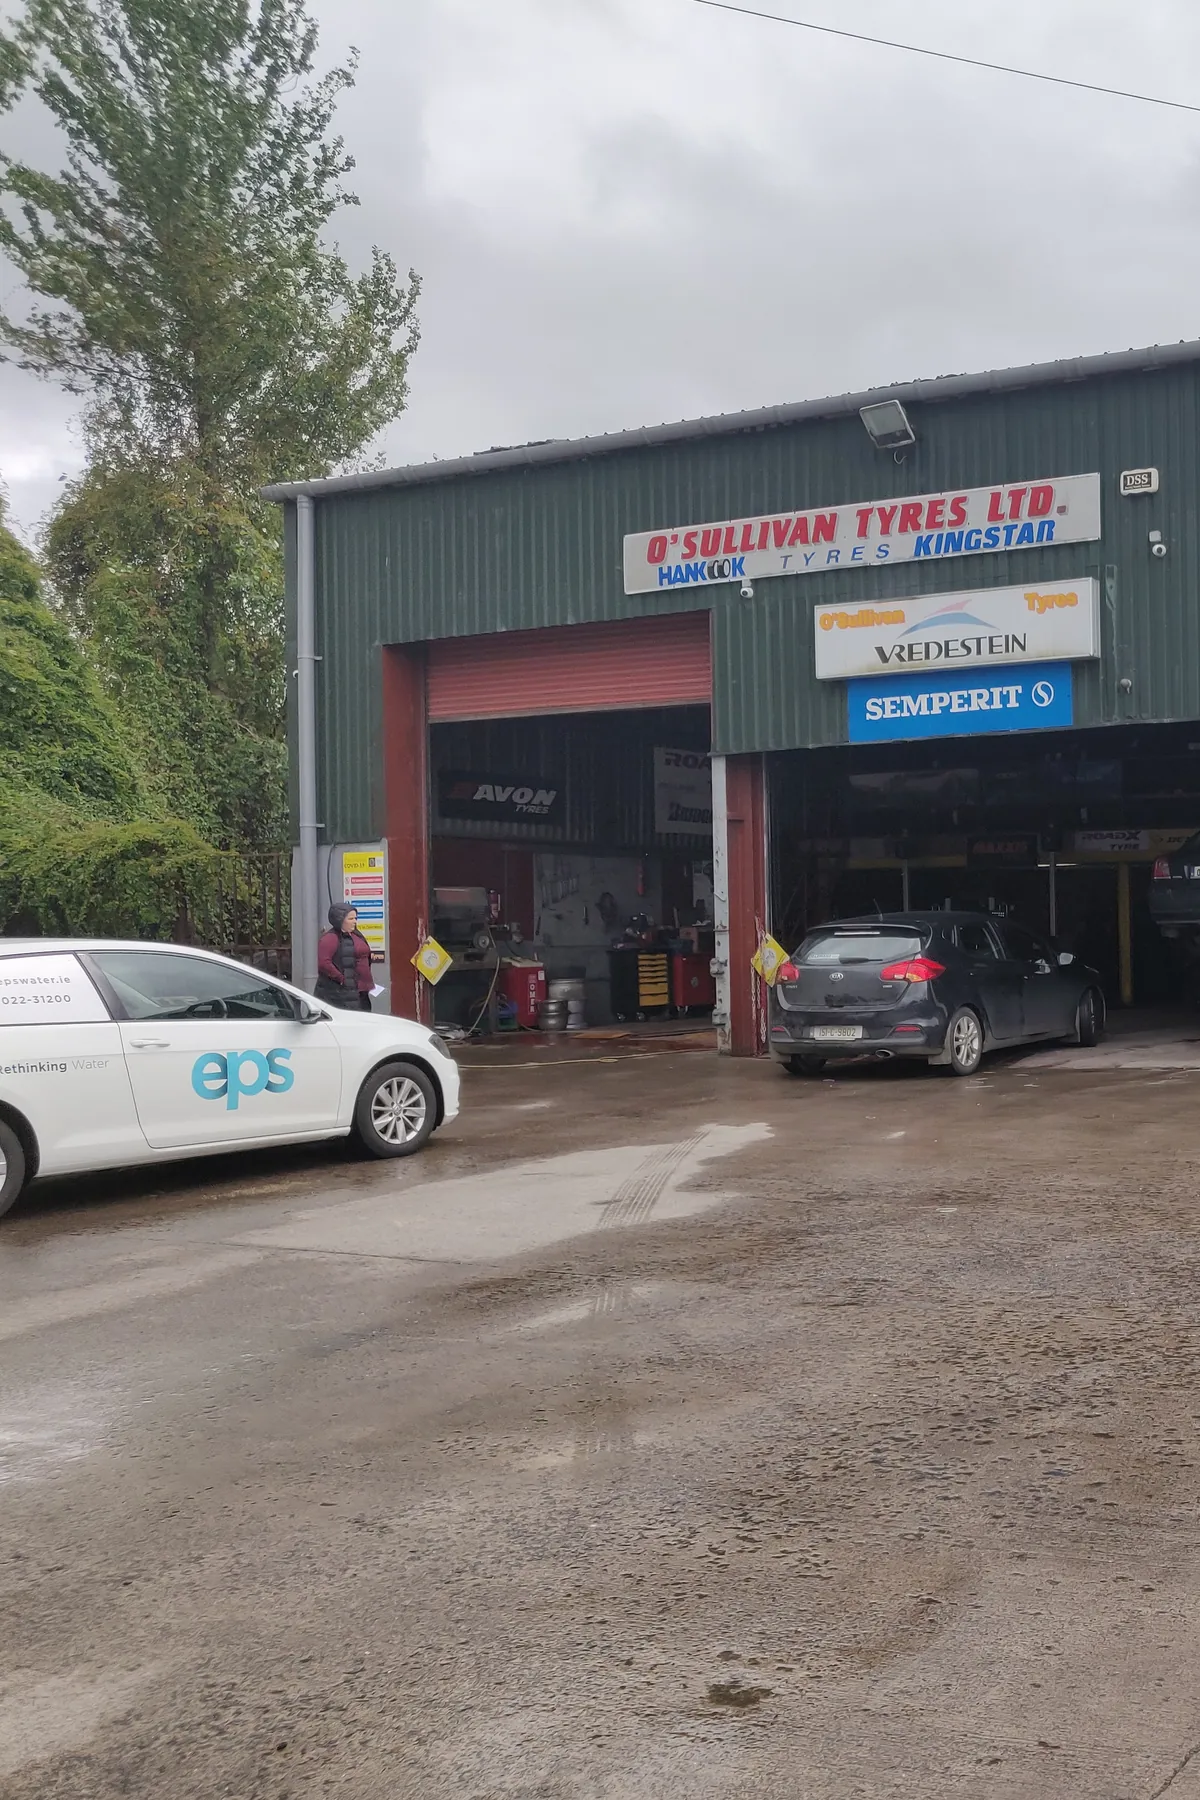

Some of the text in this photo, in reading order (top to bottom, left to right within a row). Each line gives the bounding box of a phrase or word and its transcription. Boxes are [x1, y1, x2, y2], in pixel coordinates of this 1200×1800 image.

[1126, 473, 1148, 486] DSS
[647, 484, 1069, 565] O'SULLIVAN TYRES LTD.
[658, 520, 1056, 586] HANKOOK TYRES KINGSTAR
[819, 592, 1078, 631] O'Sullivan Tyres
[874, 633, 1027, 664] VREDESTEIN
[865, 685, 1022, 721] SEMPERIT
[664, 752, 711, 770] ROA
[473, 784, 557, 806] AVON
[515, 803, 551, 815] TYRES
[1, 994, 71, 1005] 022-31200
[72, 1060, 109, 1070] Water
[191, 1047, 294, 1110] eps
